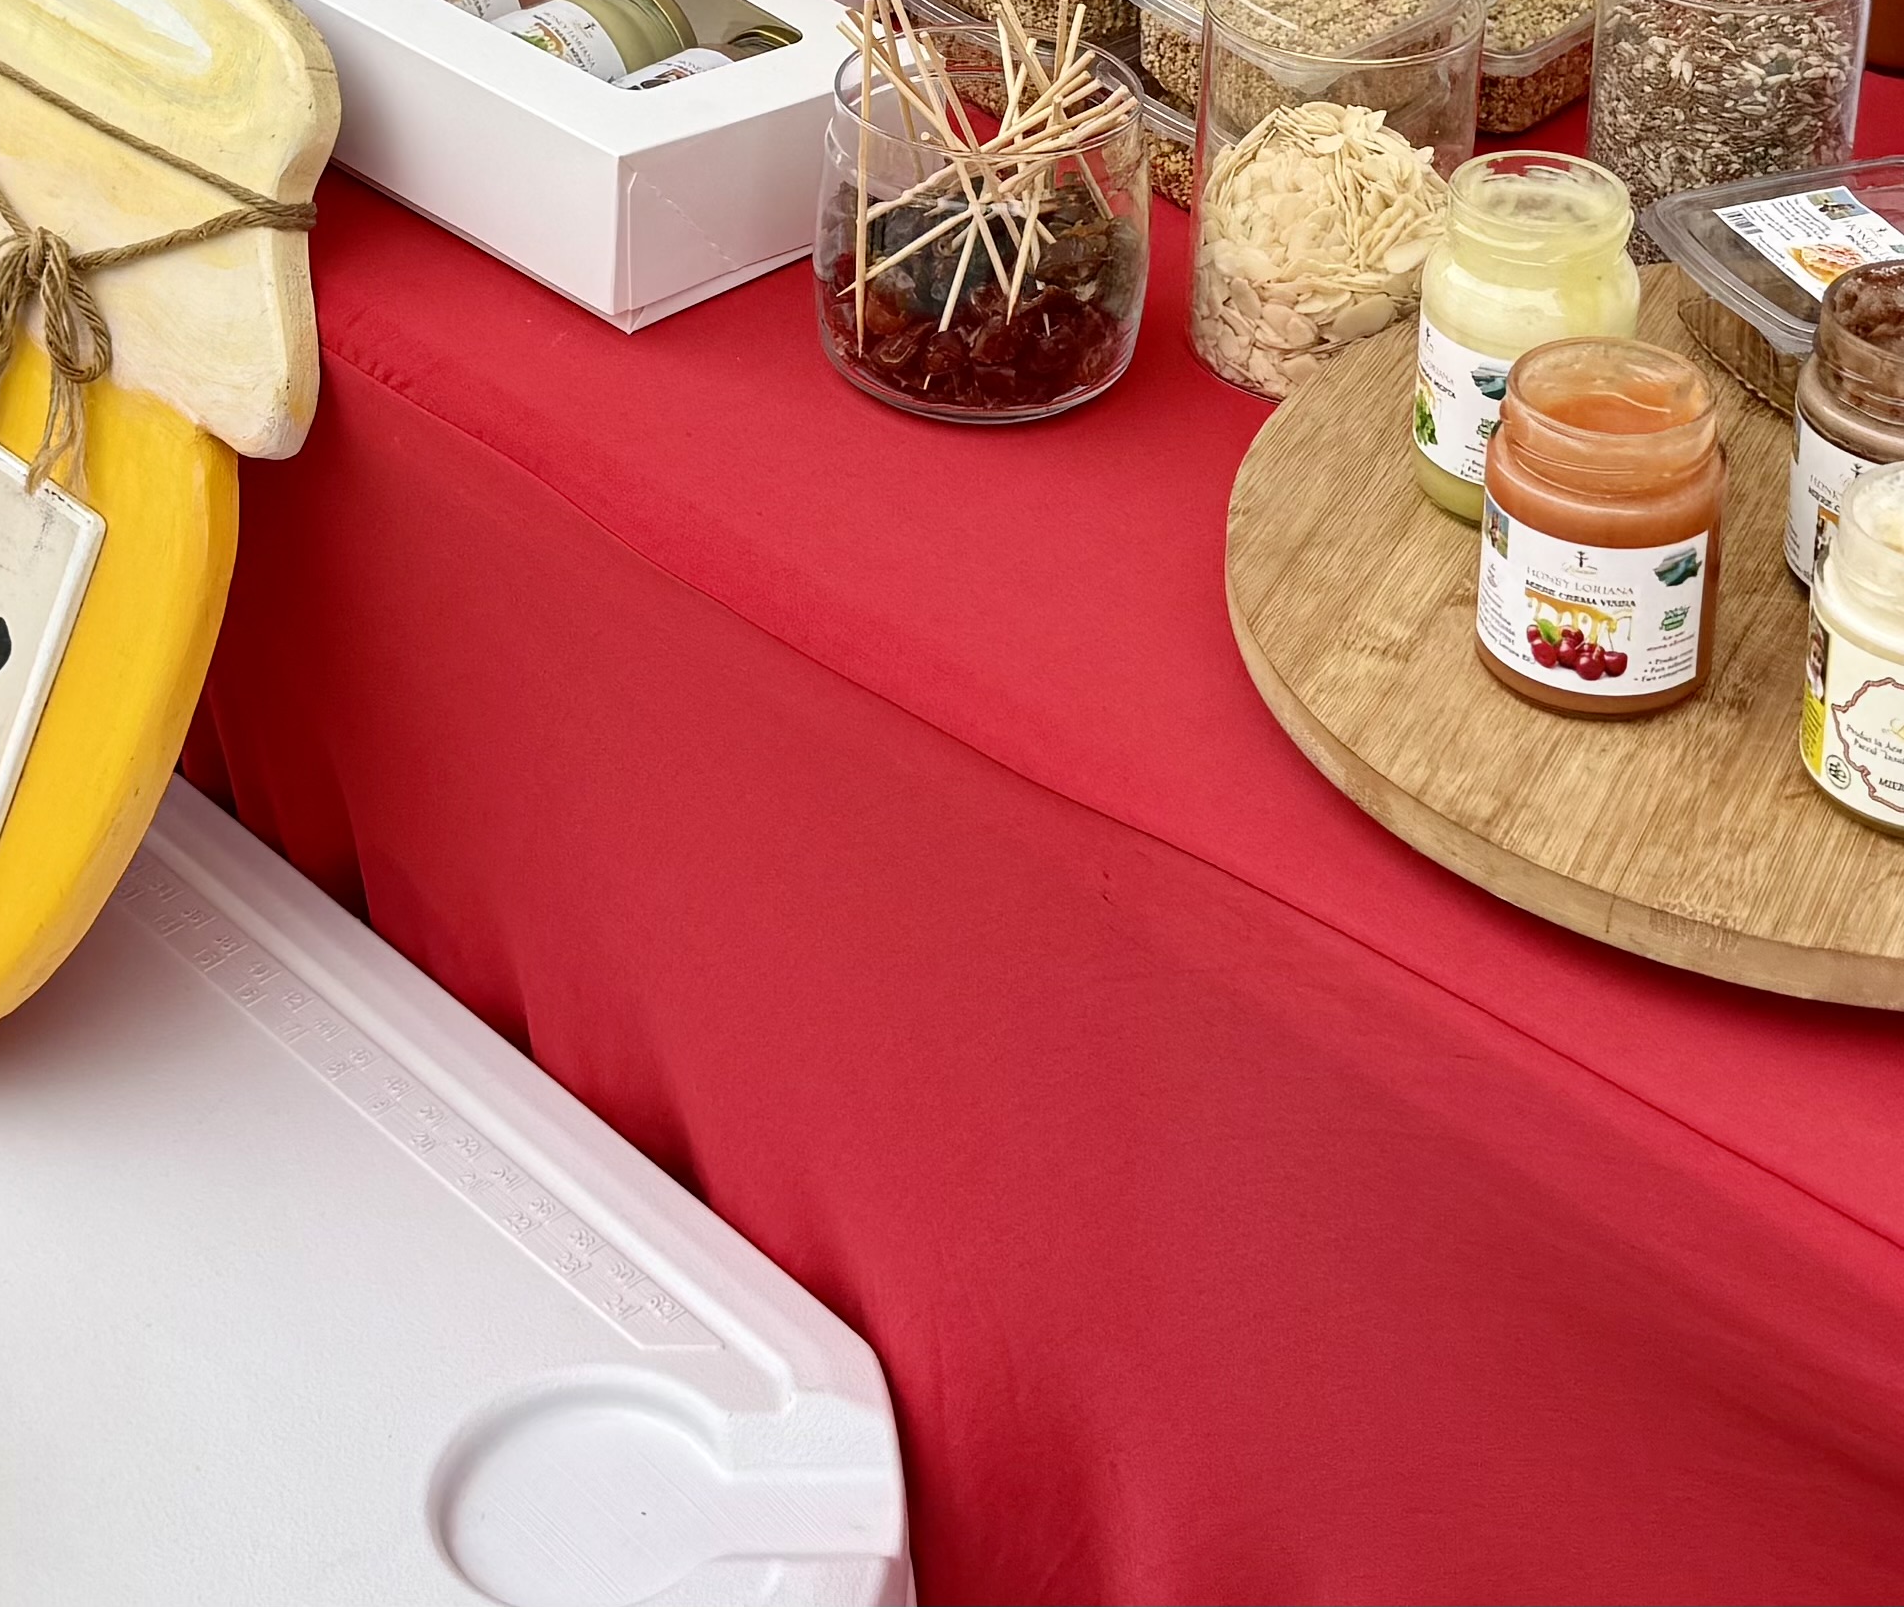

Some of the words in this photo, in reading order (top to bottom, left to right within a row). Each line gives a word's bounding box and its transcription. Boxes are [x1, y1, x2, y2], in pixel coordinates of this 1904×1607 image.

[1524, 578, 1557, 598] MIERE
[1557, 590, 1598, 607] CREMA
[1525, 565, 1571, 590] HONEY
[1574, 580, 1635, 596] LORIANA
